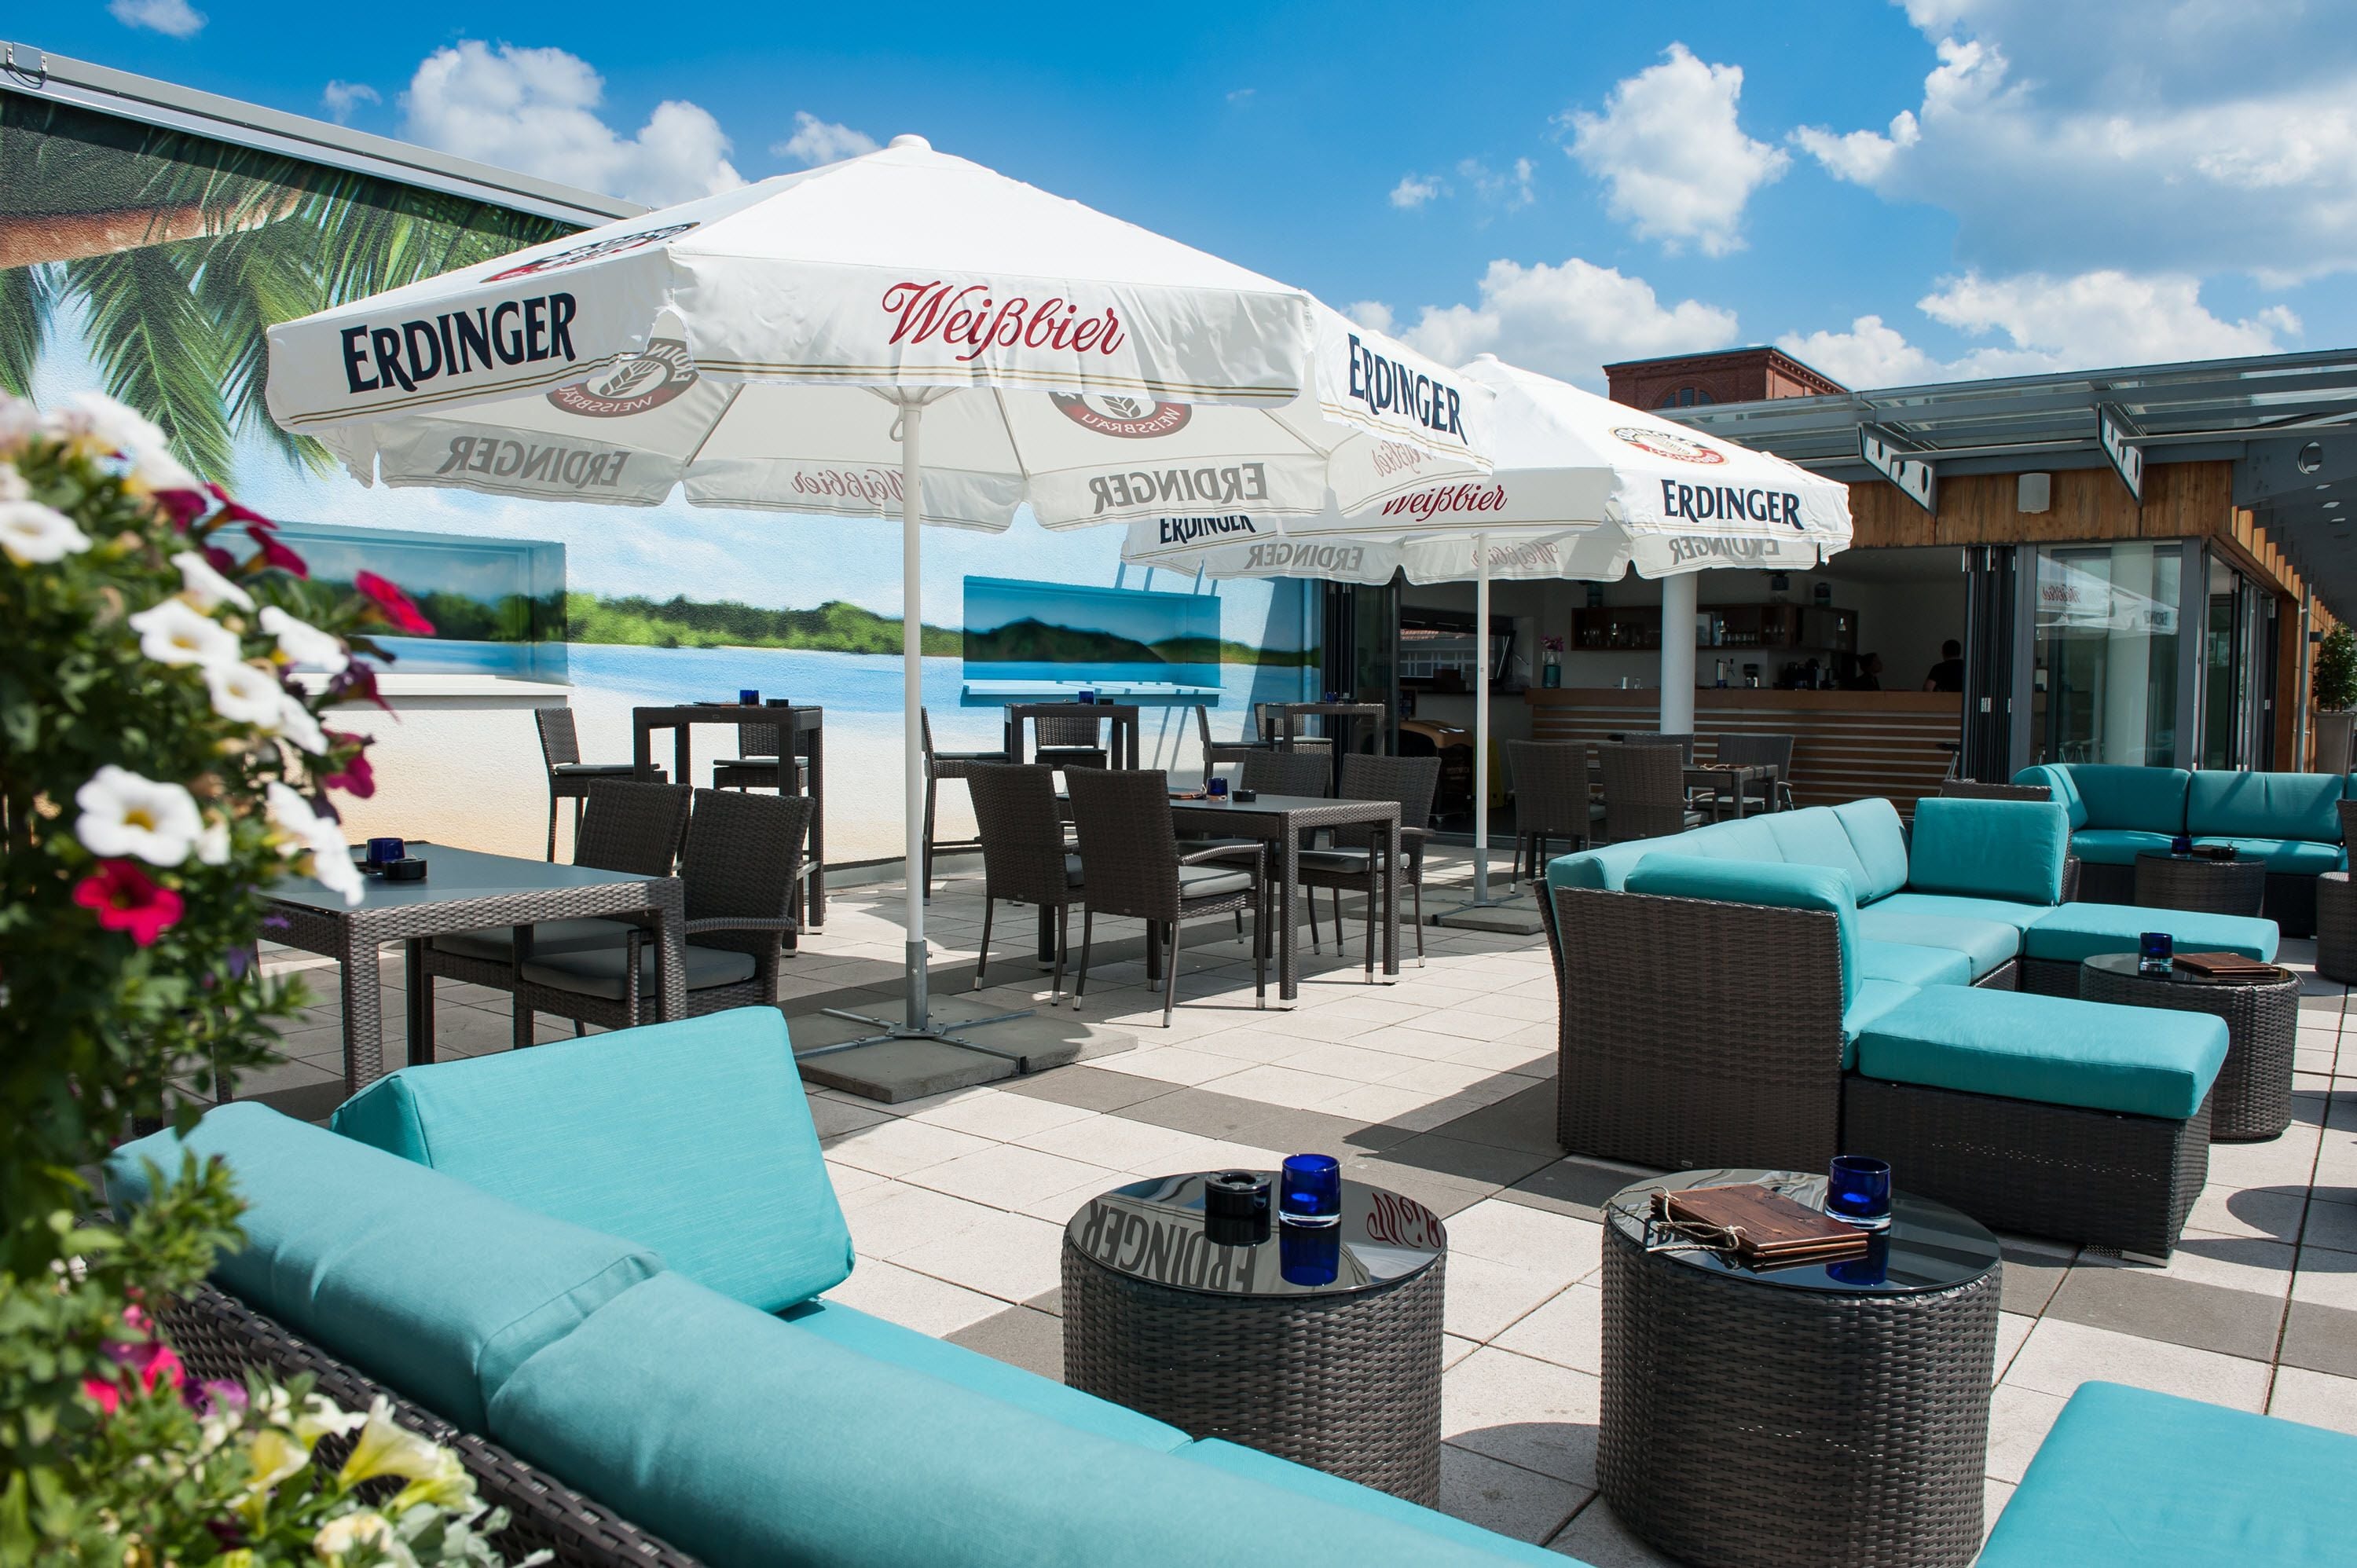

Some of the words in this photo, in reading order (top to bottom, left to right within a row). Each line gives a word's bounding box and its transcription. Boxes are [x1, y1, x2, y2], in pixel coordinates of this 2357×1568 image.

[340, 291, 577, 394] ERDINGER
[881, 279, 1126, 361] Weißbier
[1347, 332, 1468, 445] ERDINGER
[1660, 478, 1805, 530] ERDINGER
